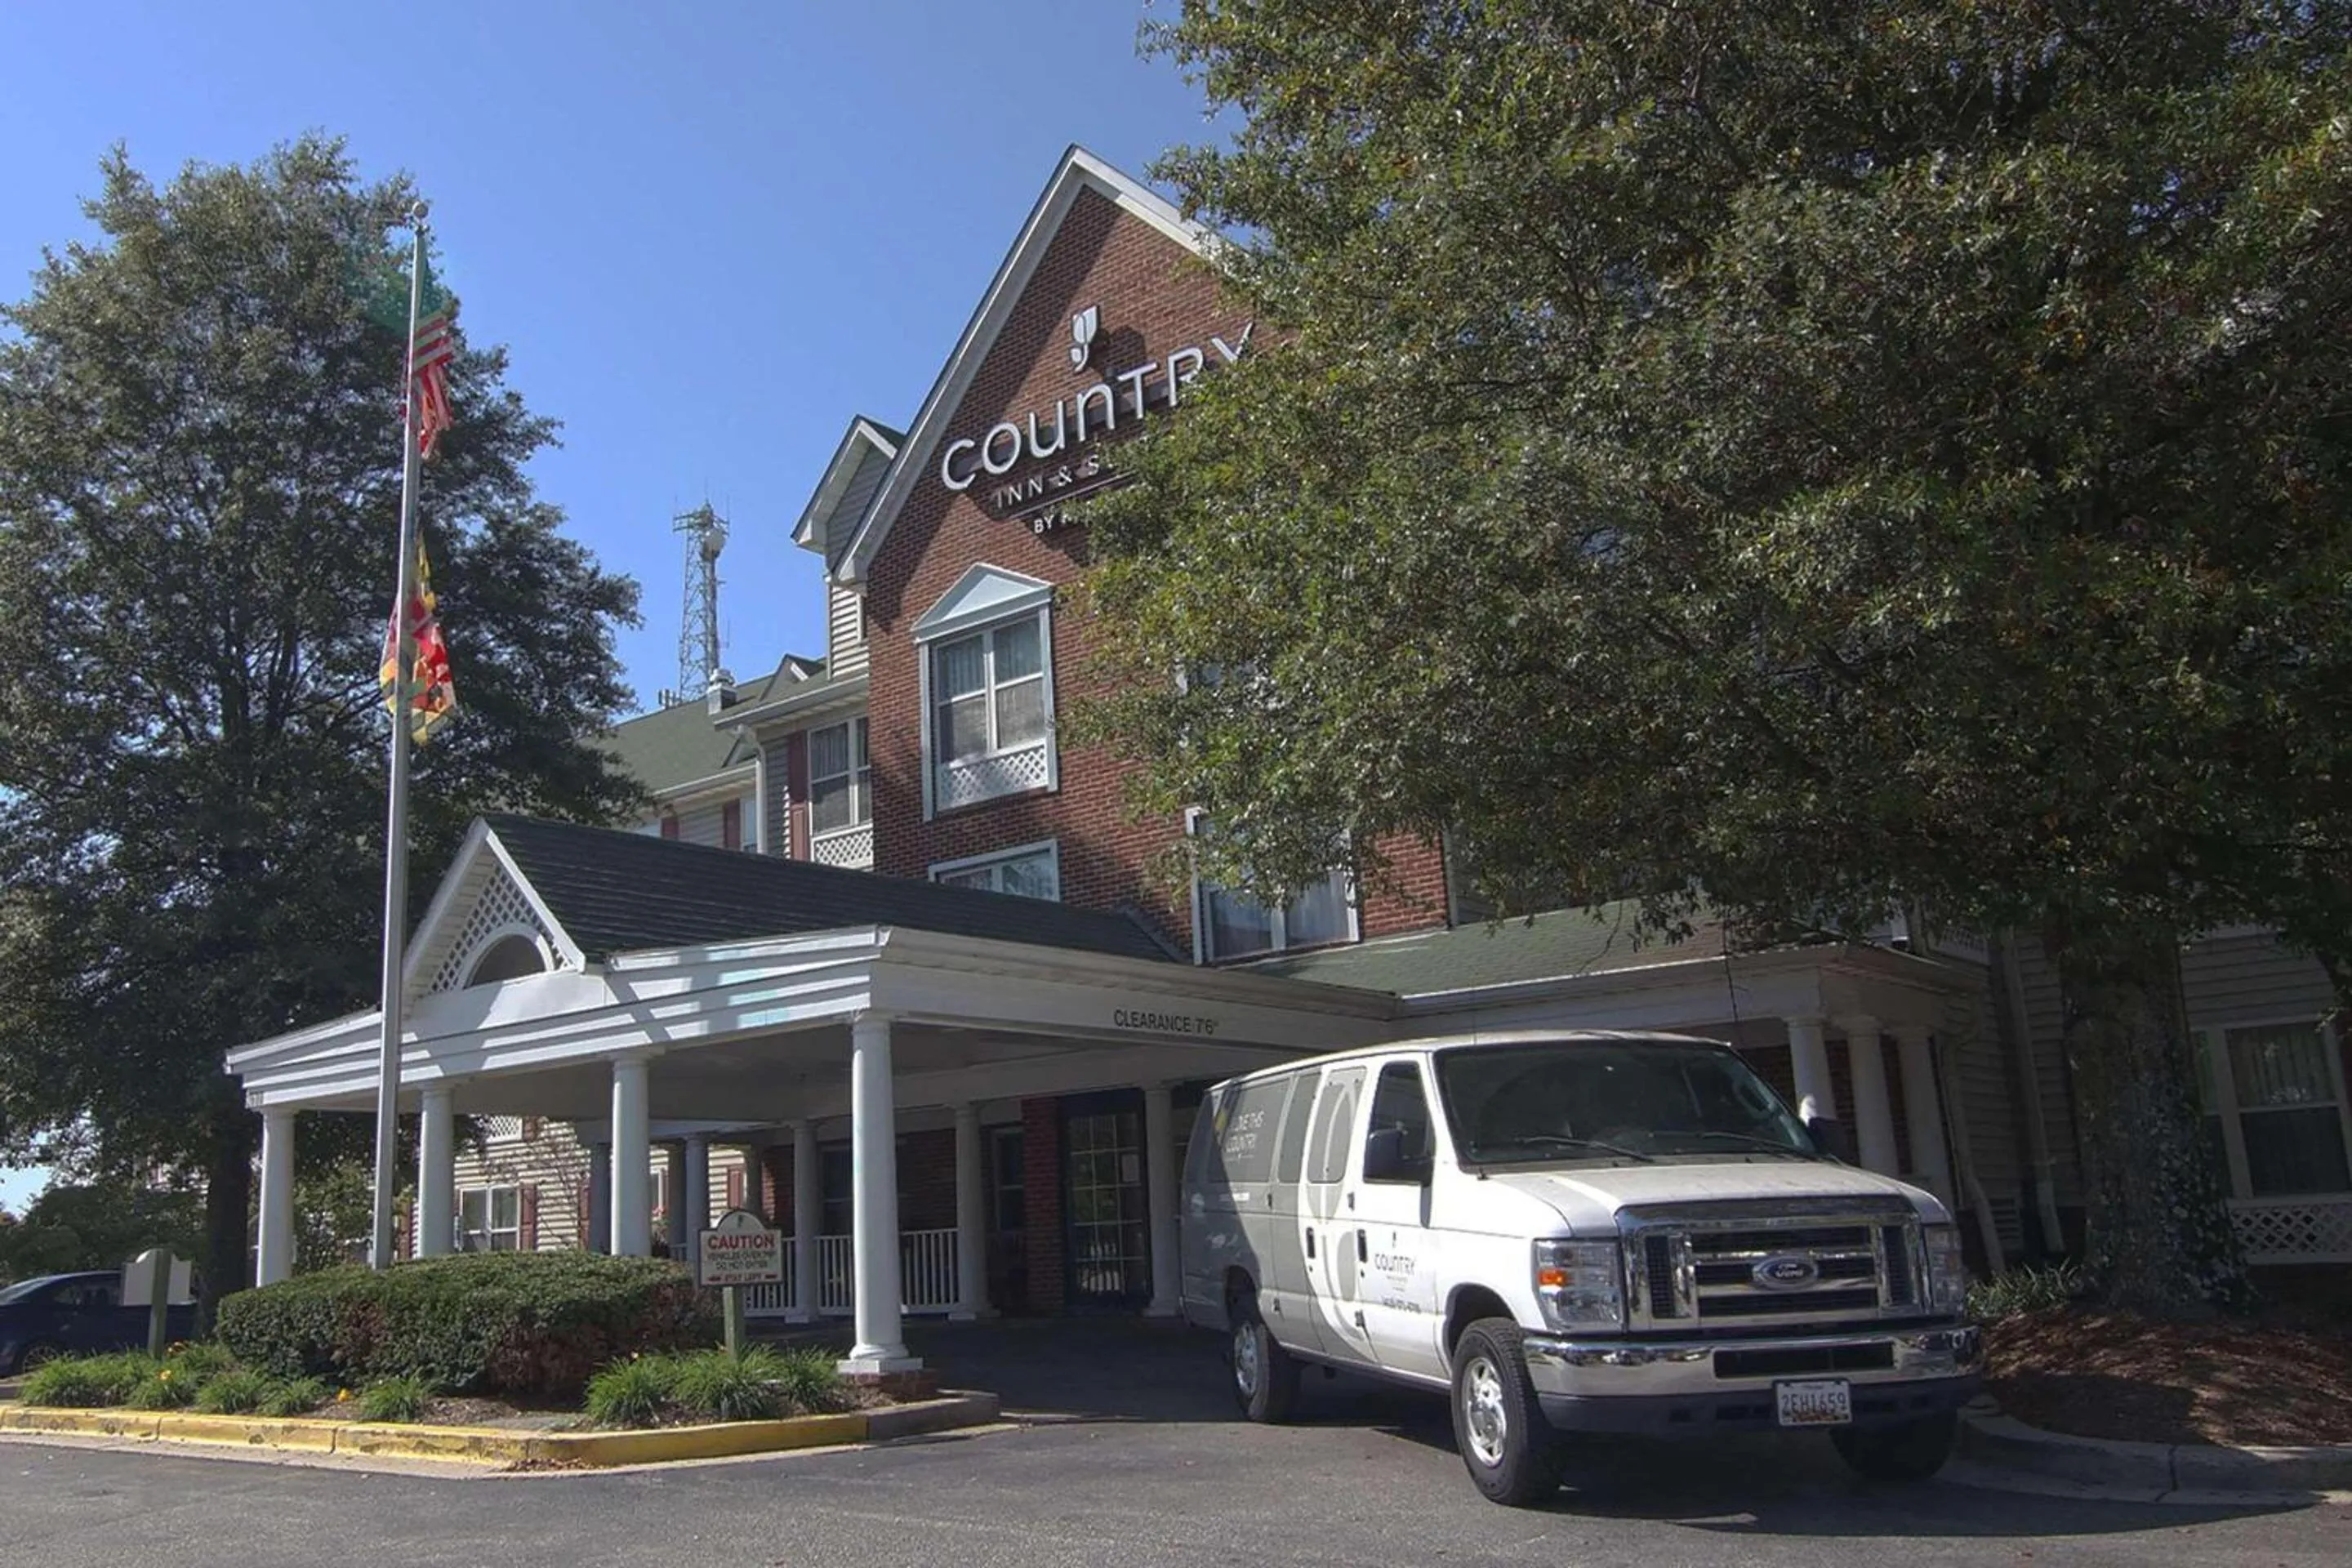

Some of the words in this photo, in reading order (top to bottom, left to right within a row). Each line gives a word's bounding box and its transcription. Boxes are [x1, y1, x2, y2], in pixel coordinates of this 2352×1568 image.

[941, 322, 1254, 490] COUNTRY
[996, 475, 1044, 508] INN
[1058, 465, 1073, 488] &
[1033, 514, 1055, 533] BY
[1113, 1009, 1192, 1033] CLEARANCE
[707, 1234, 776, 1250] CAUTION
[1775, 1263, 1804, 1278] Ford
